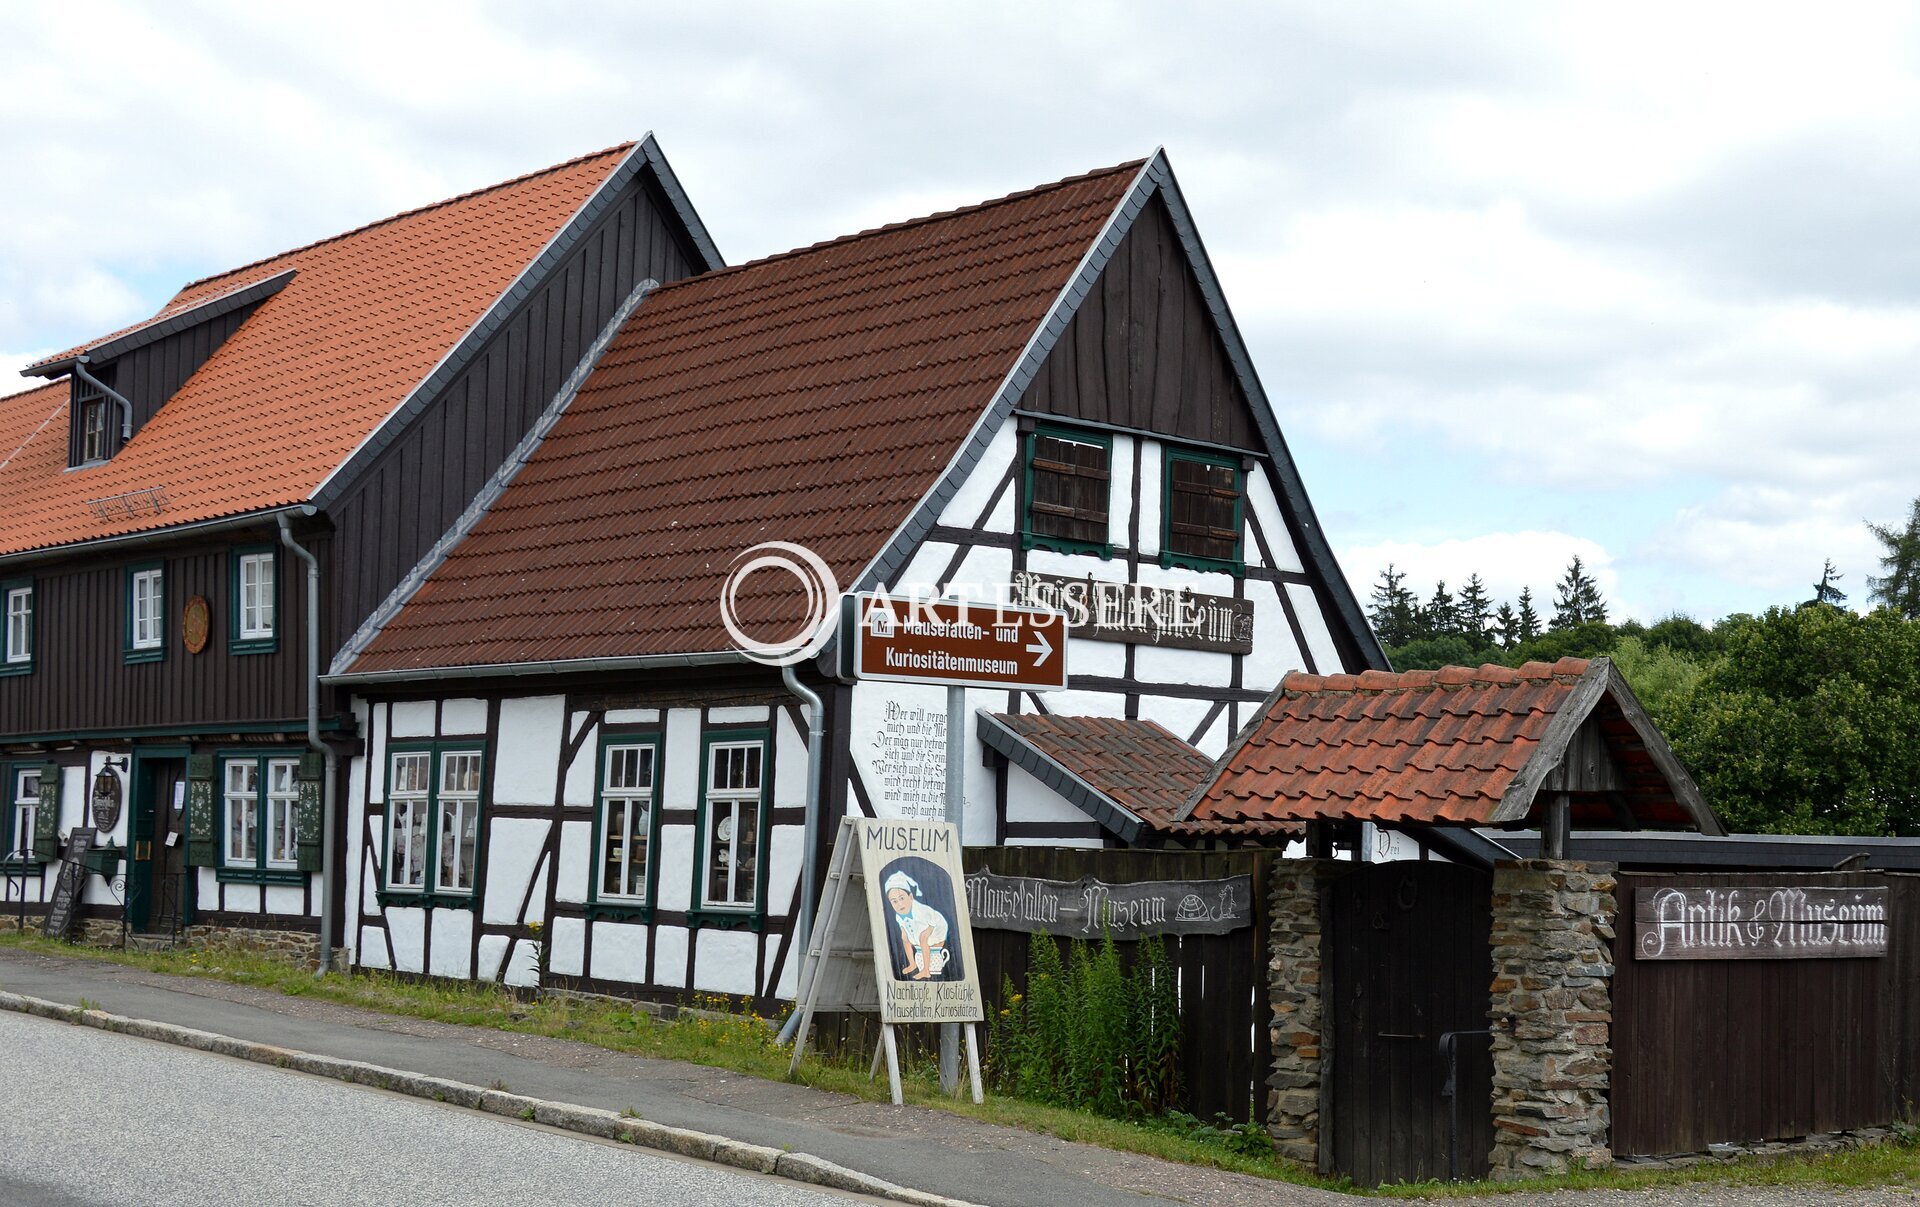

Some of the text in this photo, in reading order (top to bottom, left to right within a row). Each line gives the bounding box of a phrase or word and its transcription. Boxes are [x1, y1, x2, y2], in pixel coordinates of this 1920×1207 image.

[903, 615, 1019, 644] Mausefallen- und
[885, 646, 1018, 676] Kuriositätenmuseum
[909, 704, 925, 721] will
[886, 722, 904, 736] mich
[907, 722, 920, 734] und
[921, 722, 932, 735] die
[871, 730, 893, 748] Der
[893, 737, 909, 750] mag
[910, 738, 924, 748] nur
[884, 748, 900, 760] sich
[901, 748, 915, 760] und
[916, 749, 926, 762] die
[892, 761, 907, 777] sich
[908, 762, 923, 775] und
[923, 762, 934, 776] die
[902, 775, 921, 790] recht
[902, 788, 920, 803] mich
[901, 802, 919, 819] wohl
[866, 826, 950, 852] MUSEUM
[1641, 887, 1745, 957] Antik
[1747, 899, 1766, 946] &
